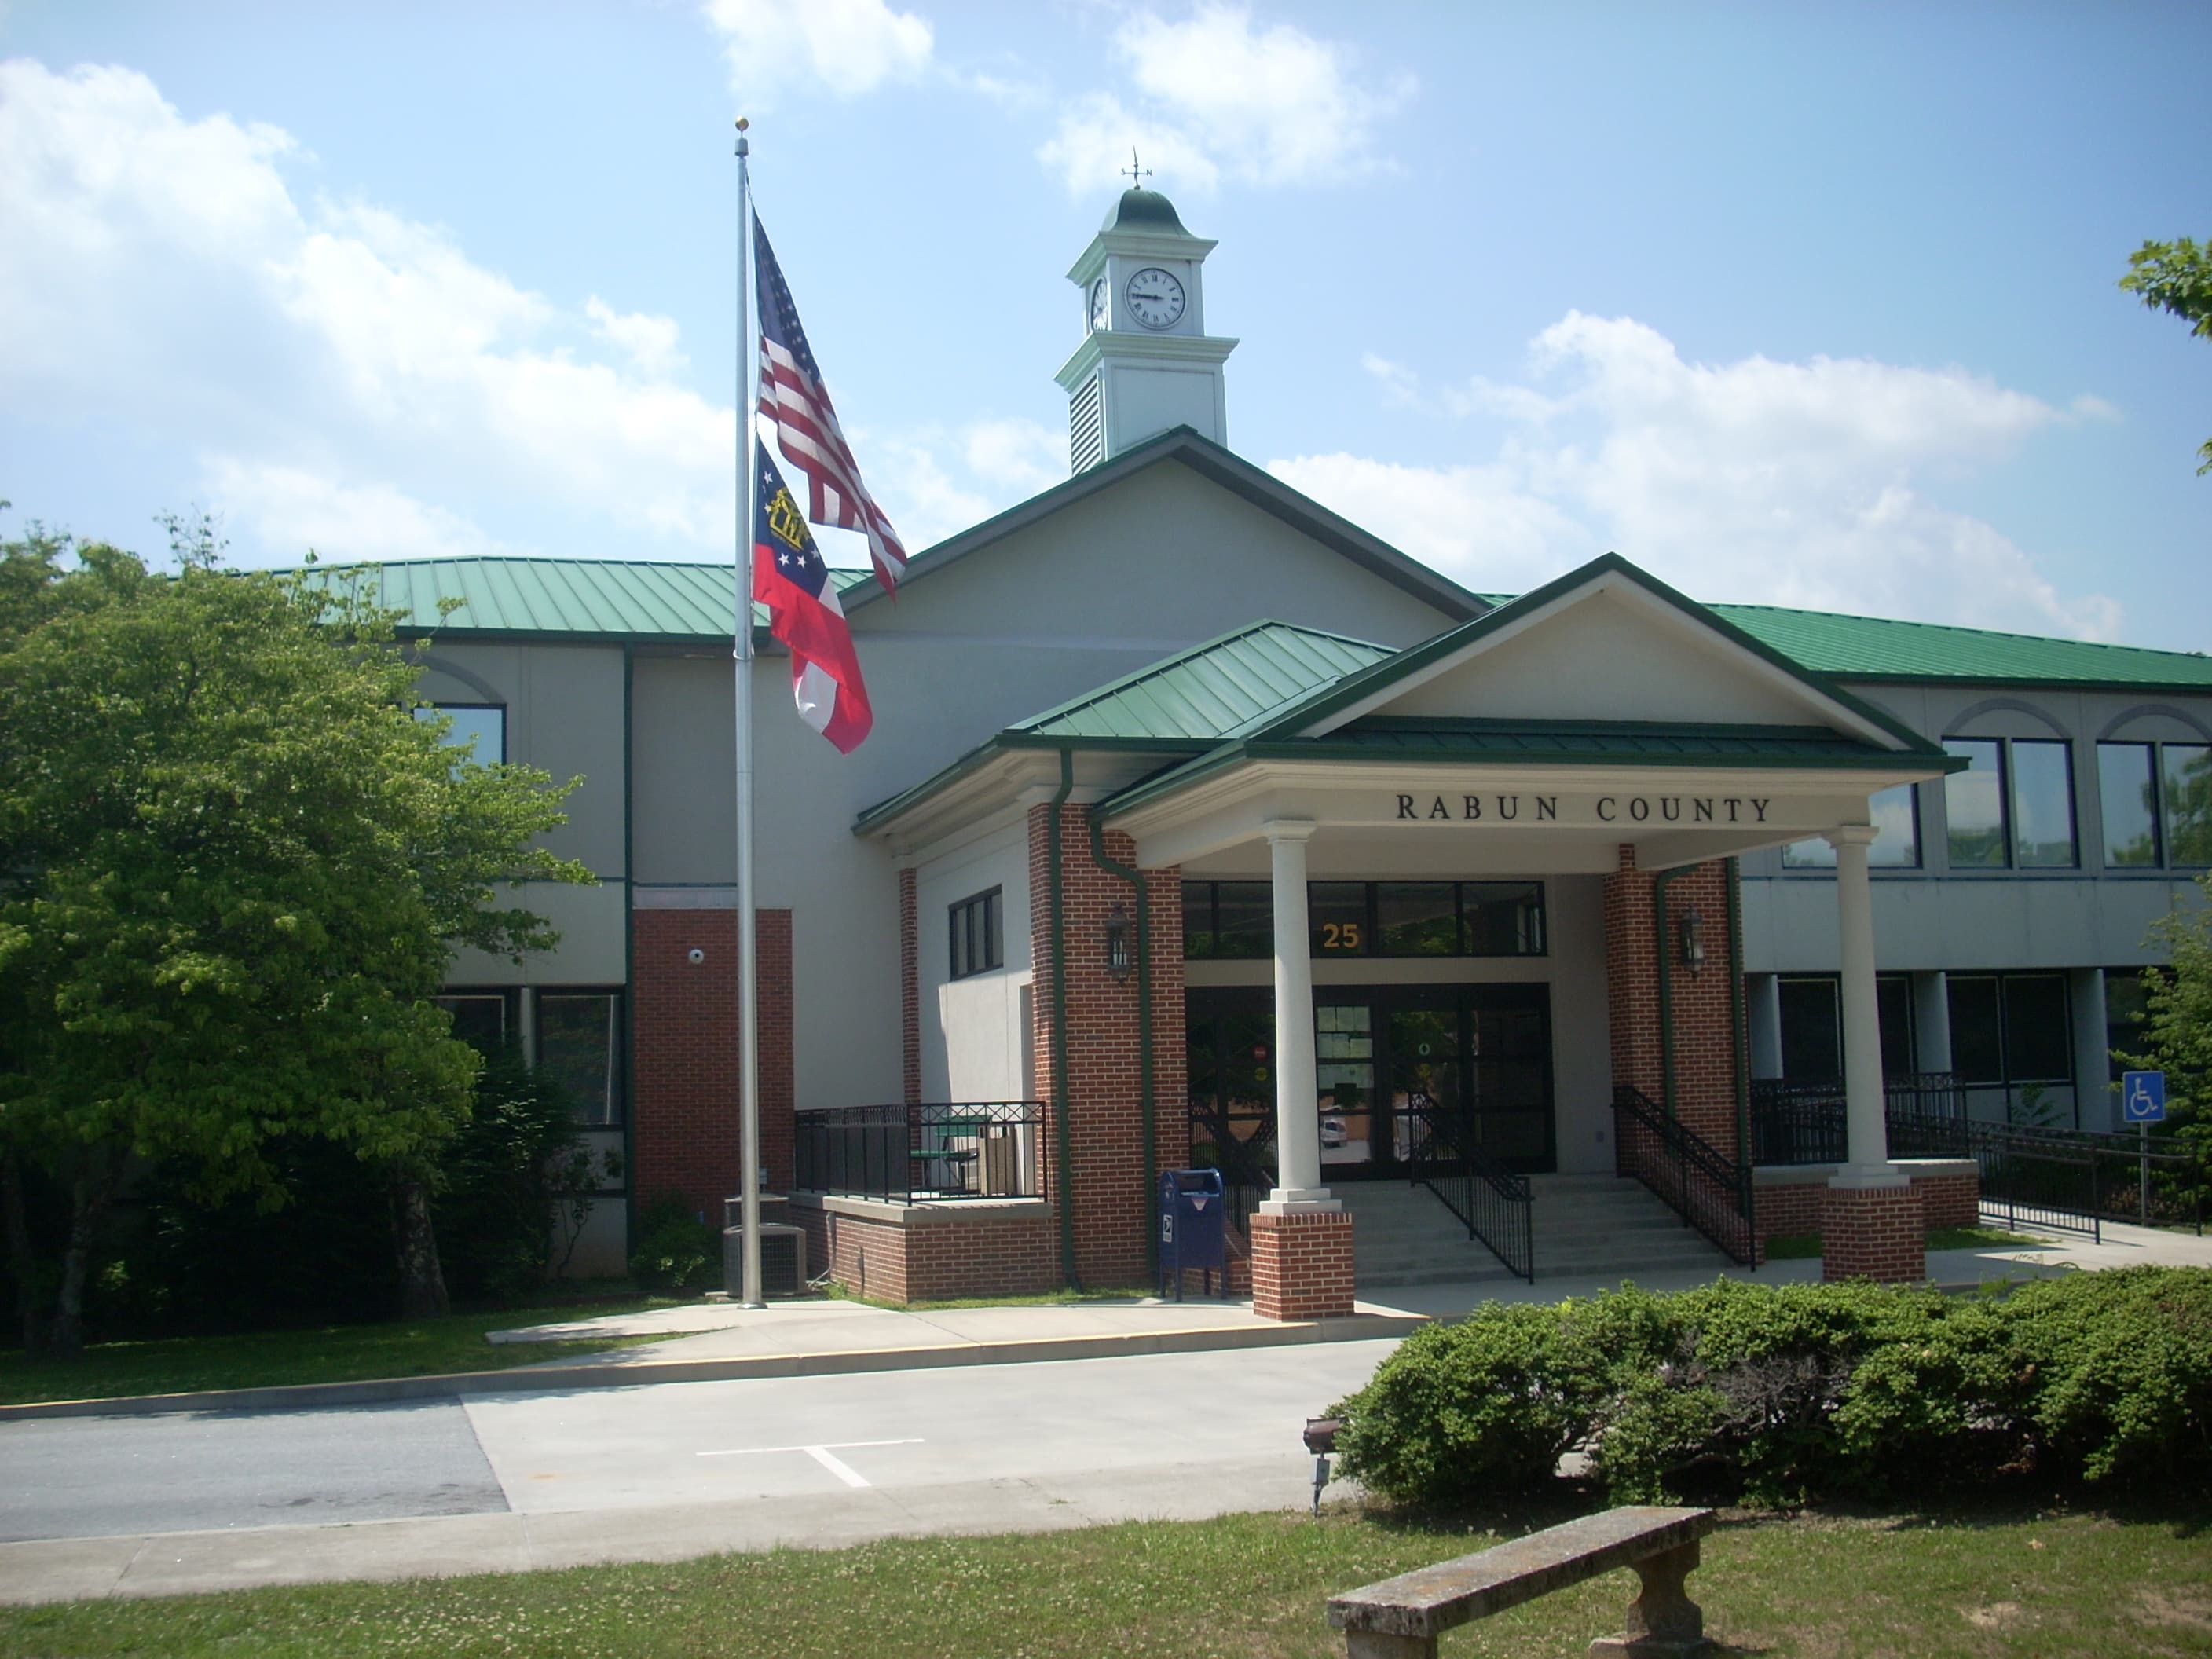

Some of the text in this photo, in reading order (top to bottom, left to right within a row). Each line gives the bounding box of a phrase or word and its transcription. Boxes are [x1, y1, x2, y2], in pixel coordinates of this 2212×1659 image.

[1396, 794, 1771, 822] RABUN COUNTY
[1323, 923, 1359, 948] 25
